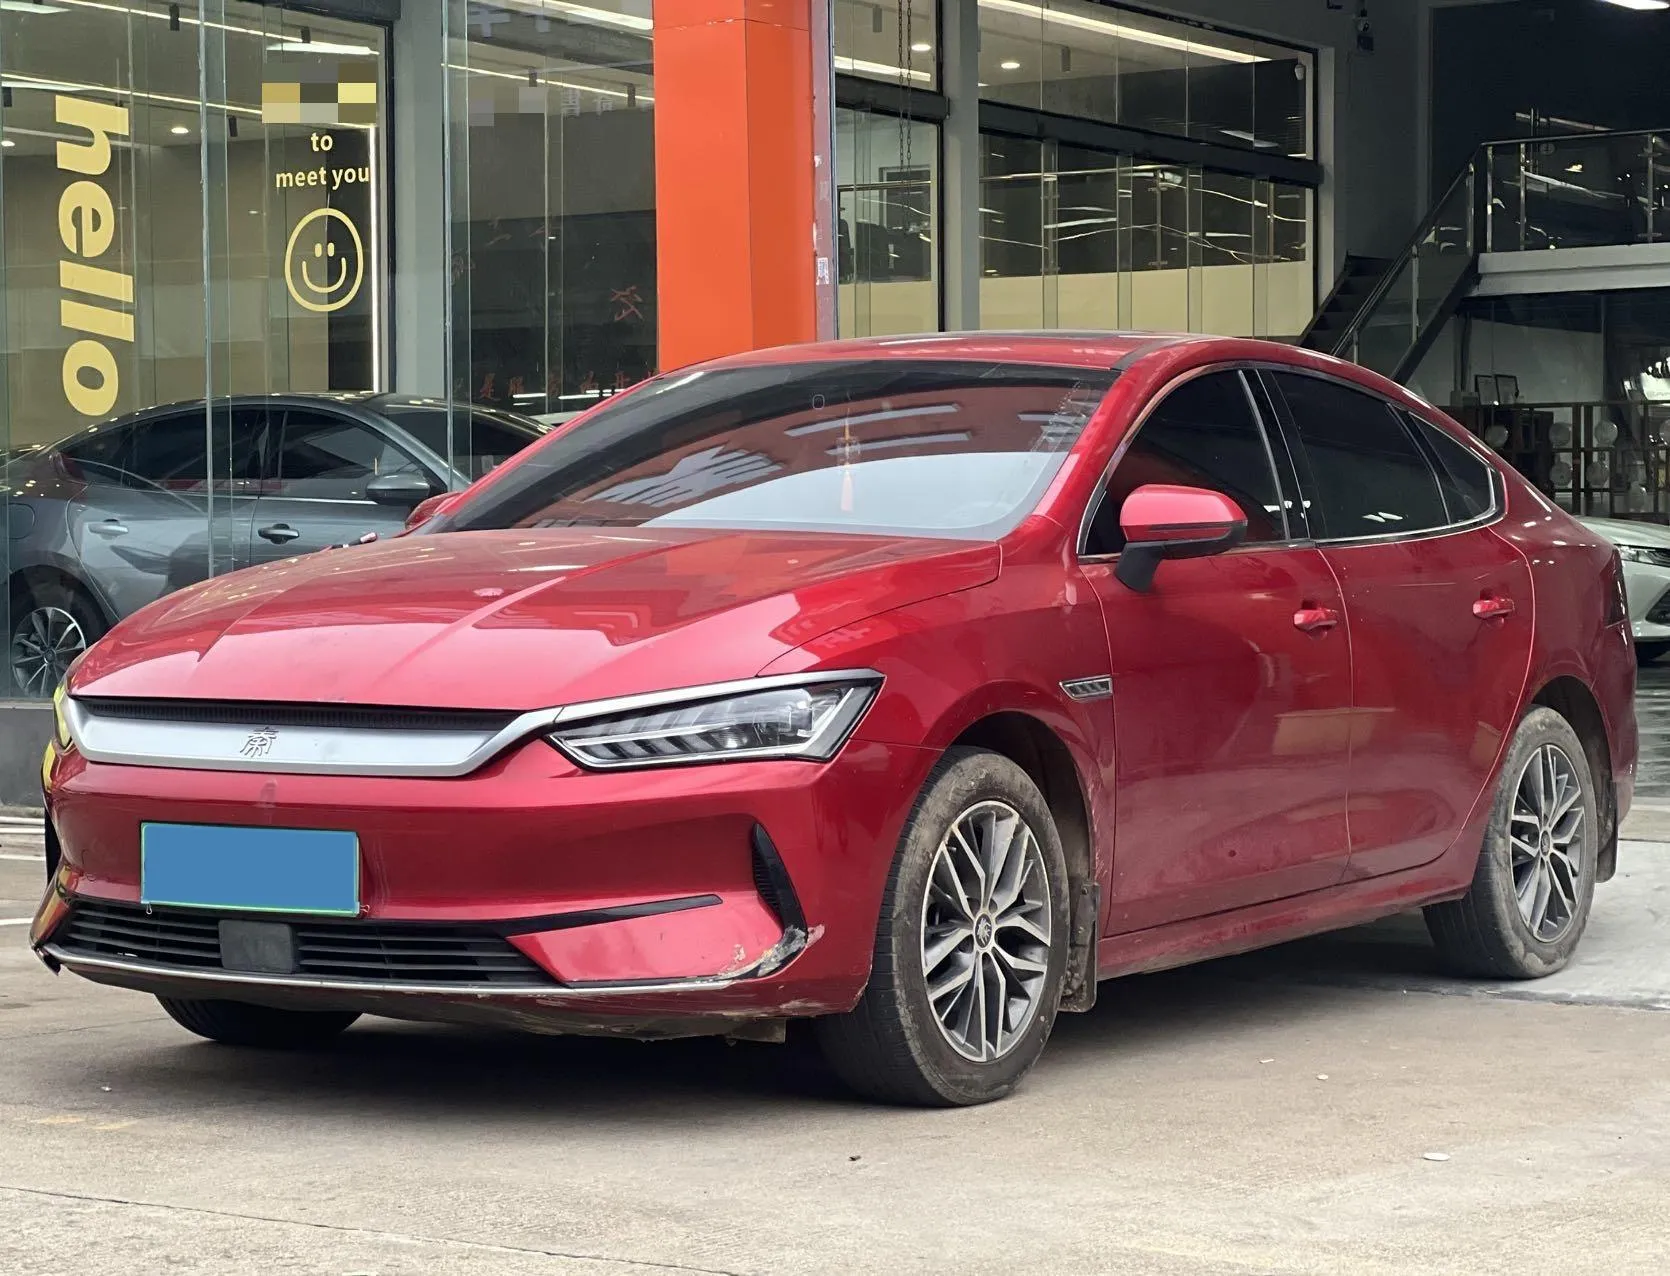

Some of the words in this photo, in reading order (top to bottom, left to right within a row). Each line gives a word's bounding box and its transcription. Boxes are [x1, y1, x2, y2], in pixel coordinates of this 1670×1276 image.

[310, 132, 333, 152] to
[275, 166, 327, 188] meet
[331, 167, 370, 191] you
[55, 95, 134, 416] hello
